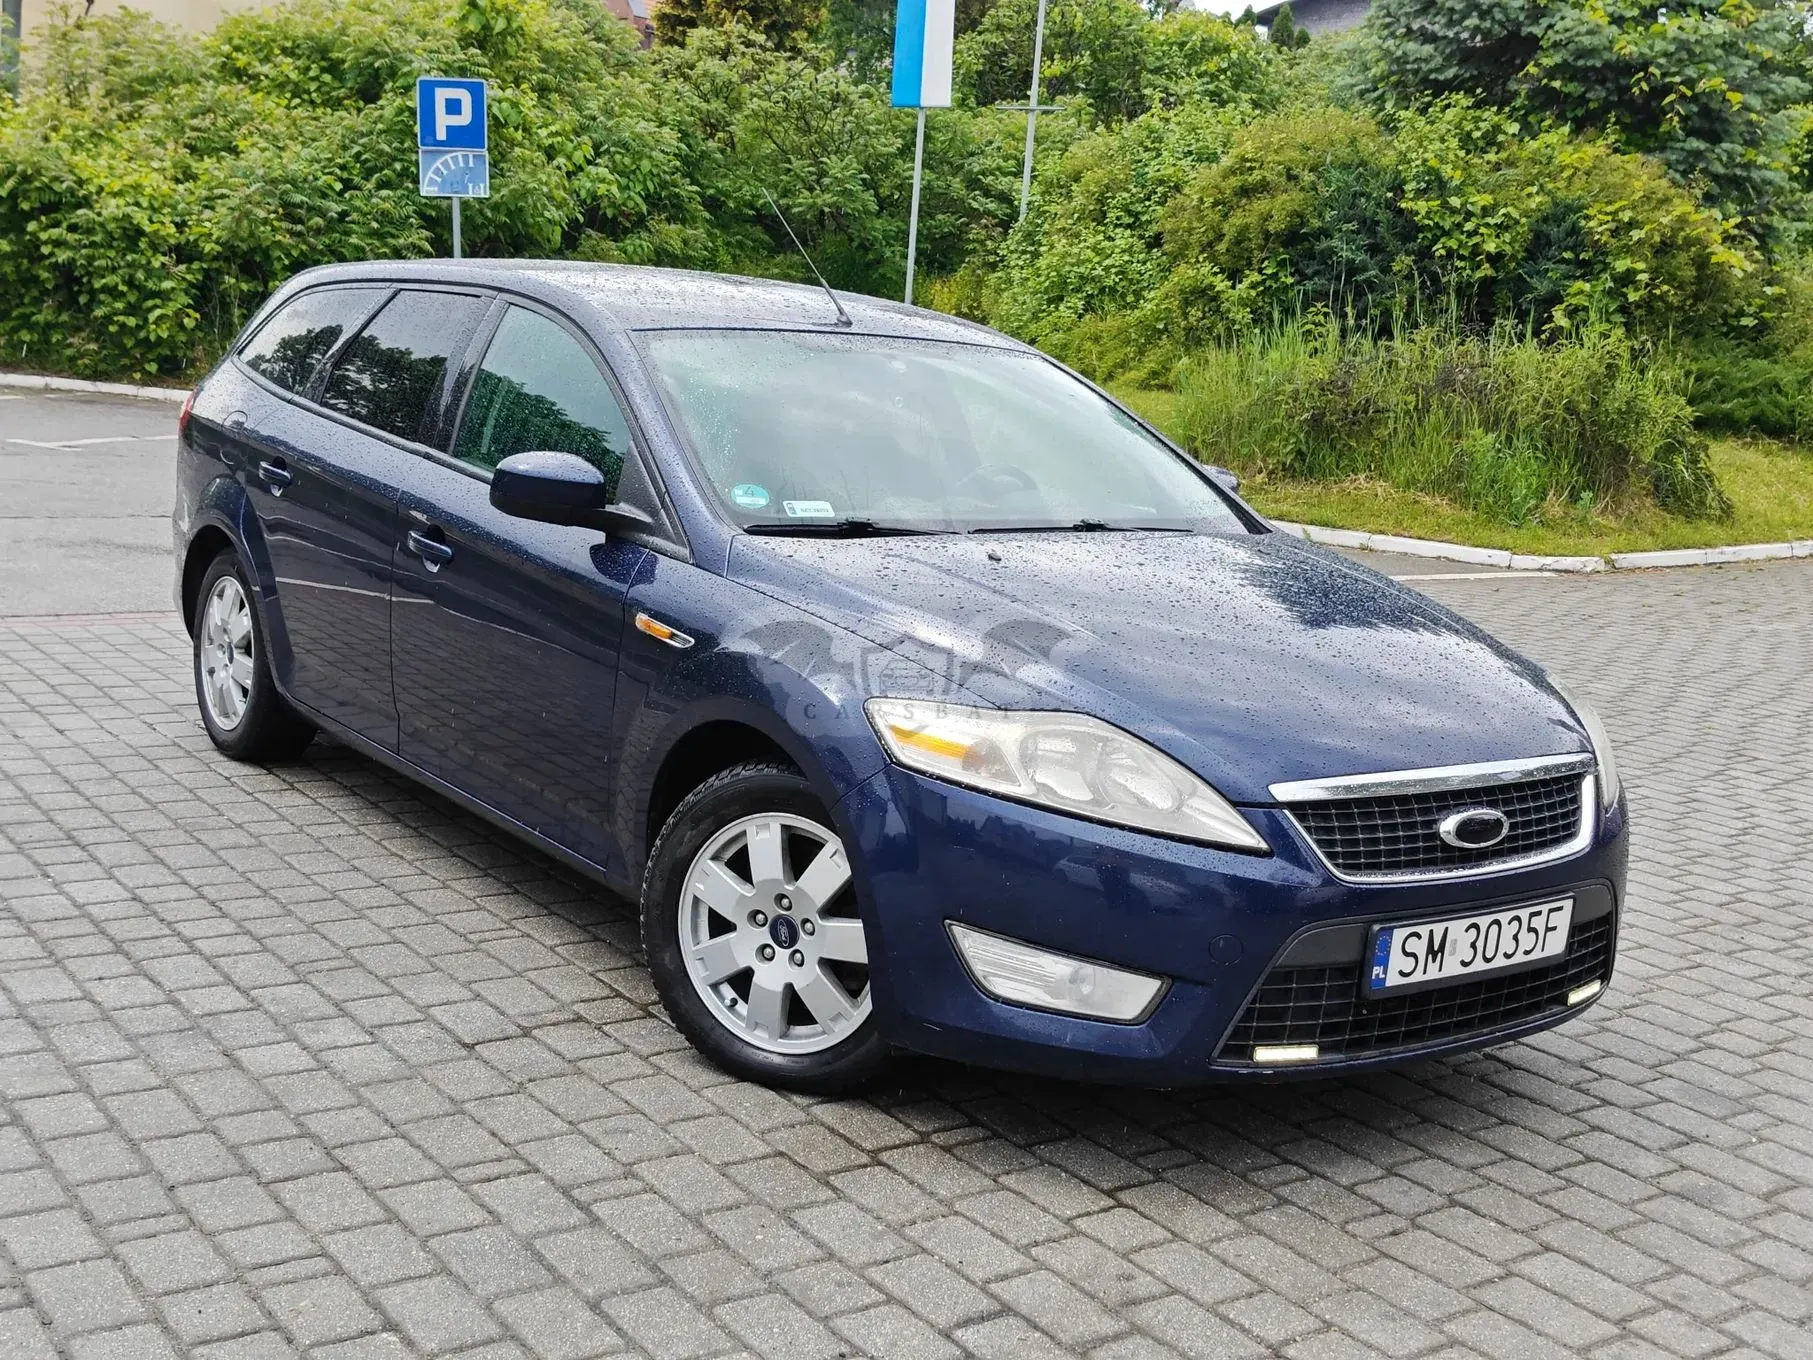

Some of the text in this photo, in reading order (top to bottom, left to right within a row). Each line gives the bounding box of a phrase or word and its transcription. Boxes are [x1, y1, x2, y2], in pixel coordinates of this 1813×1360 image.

[434, 87, 472, 140] P
[1398, 905, 1564, 978] SM 3035F
[1372, 966, 1385, 979] PL
